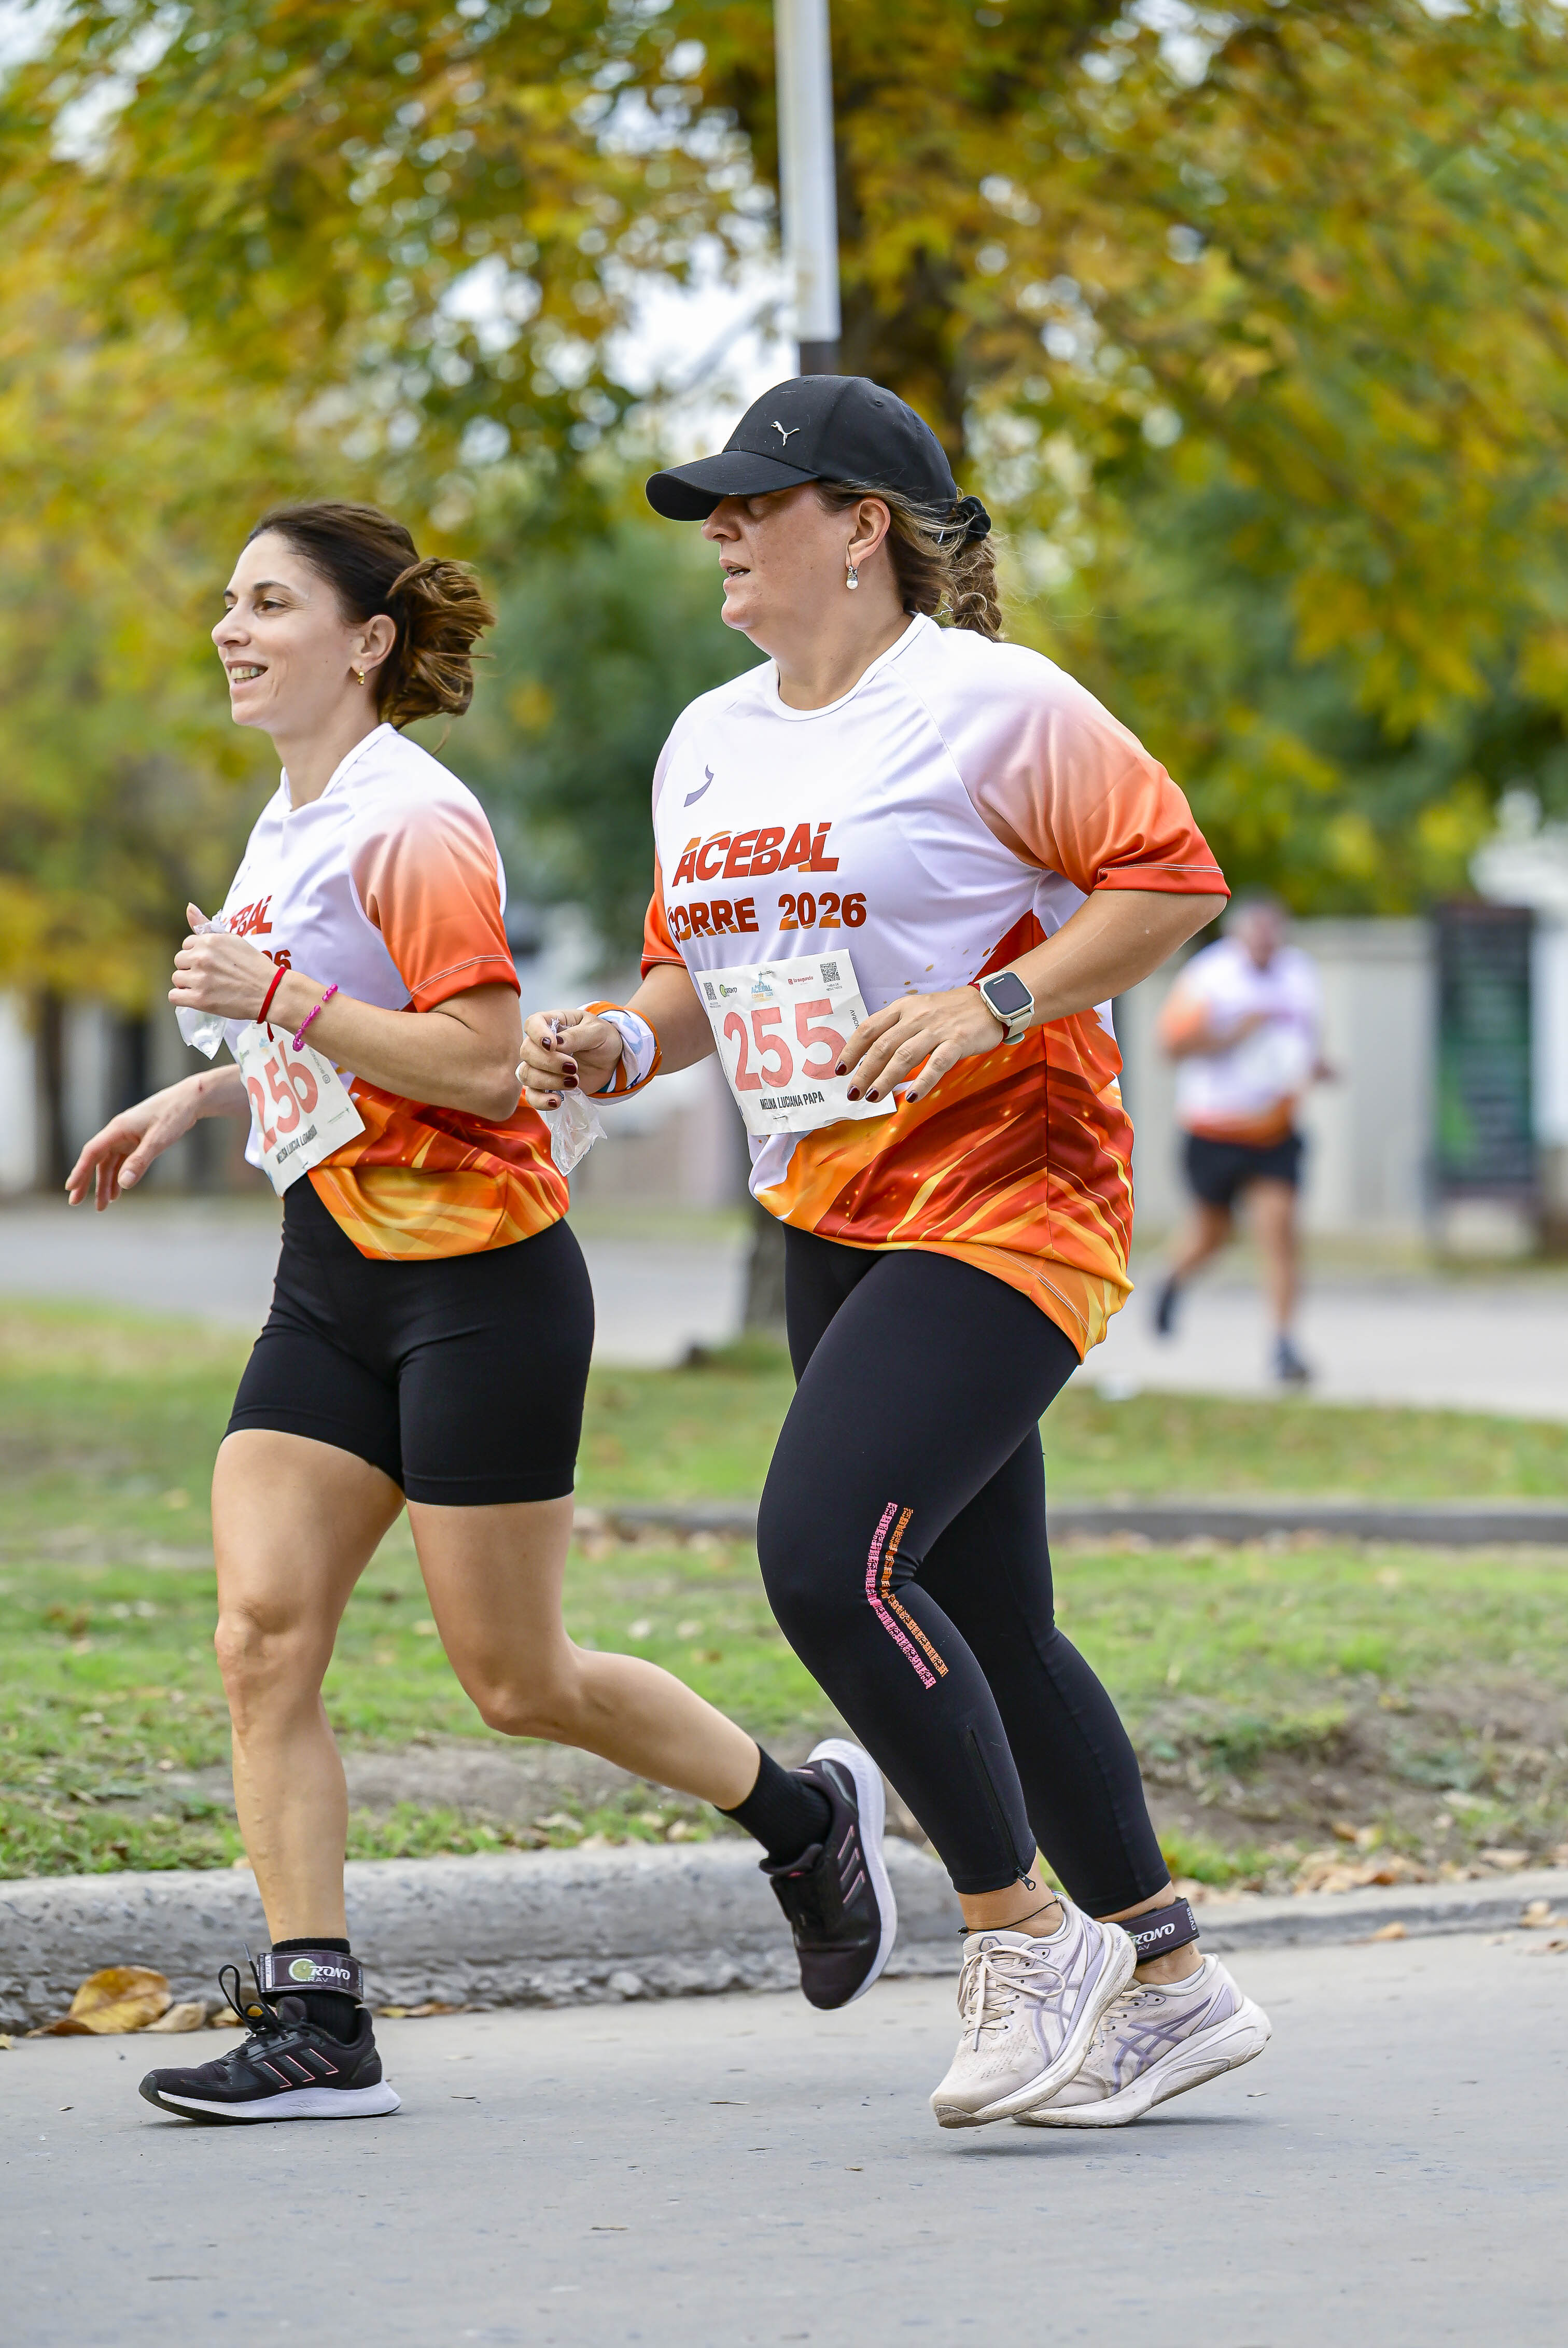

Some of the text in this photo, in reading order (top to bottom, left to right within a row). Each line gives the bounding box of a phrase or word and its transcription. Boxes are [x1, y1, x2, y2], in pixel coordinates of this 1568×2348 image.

[672, 822, 839, 887] ACEBAL
[230, 895, 272, 937] EBAL
[667, 892, 867, 944] CORRE 2026
[723, 998, 847, 1092] 255
[247, 1040, 318, 1154] 256
[760, 1091, 825, 1110] MELINA LUCIANA PAPA
[1128, 1923, 1175, 1945] RONO
[1138, 1943, 1150, 1951] AV
